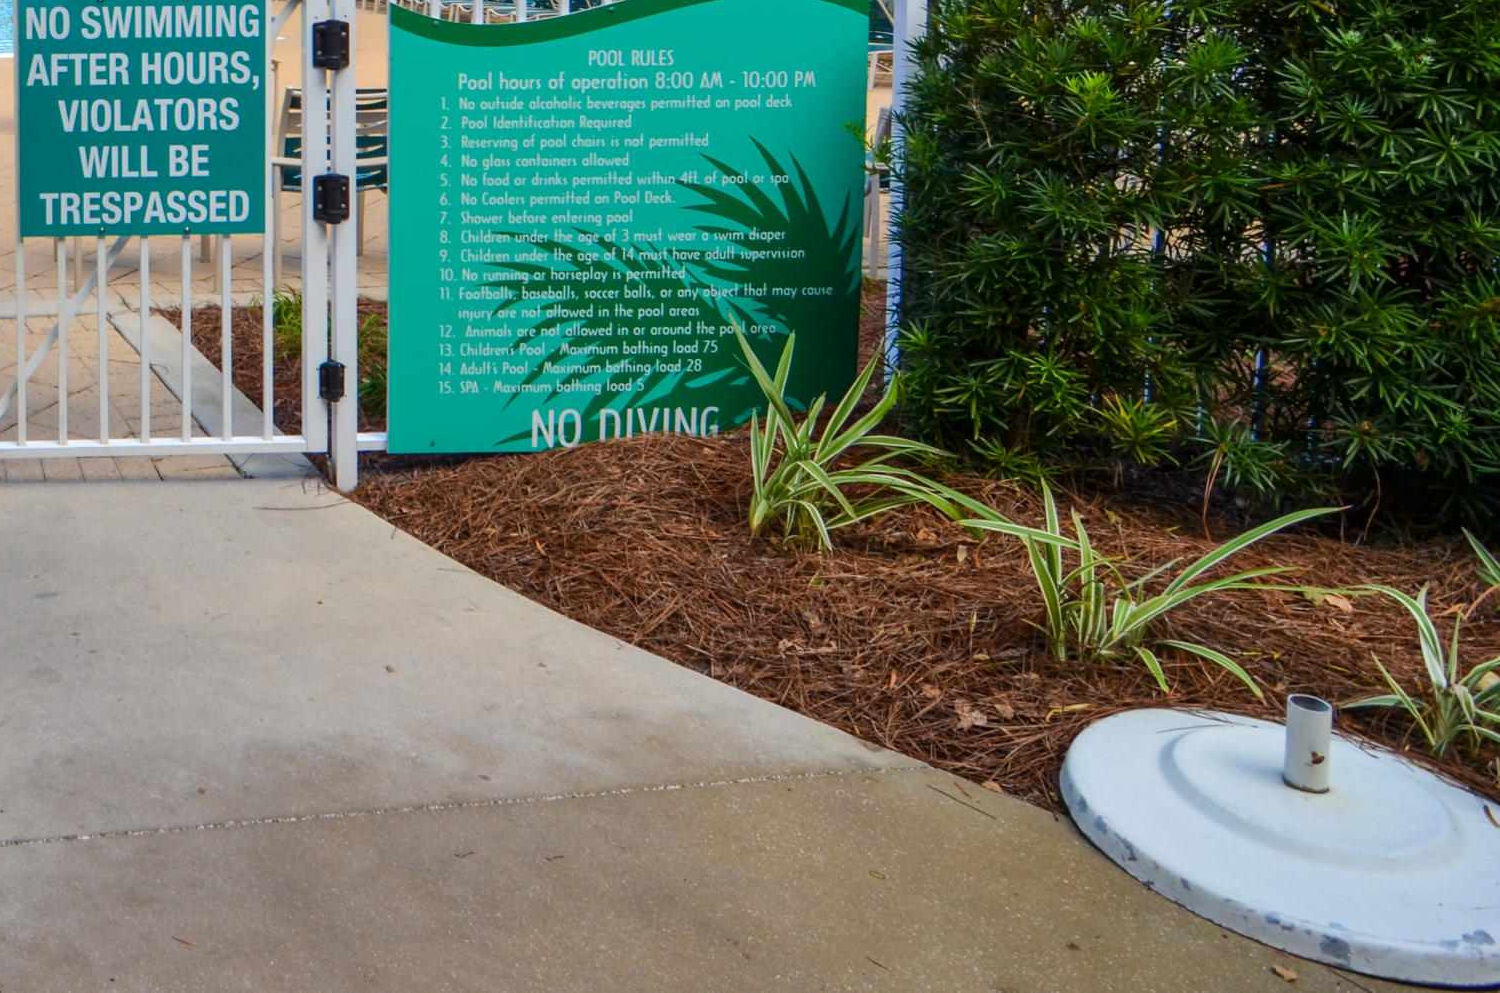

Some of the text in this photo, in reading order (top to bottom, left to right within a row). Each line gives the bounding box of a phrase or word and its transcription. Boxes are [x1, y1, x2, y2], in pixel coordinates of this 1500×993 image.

[26, 5, 259, 39] NO SWIMMING
[588, 50, 674, 66] POOL RULES
[27, 51, 259, 89] AFTER HOURS,
[459, 71, 492, 90] Pool
[499, 72, 541, 90] hours
[548, 71, 564, 89] of
[571, 71, 648, 93] operation
[655, 71, 693, 89] 8:00
[700, 71, 723, 88] AM
[743, 71, 788, 88] 10:00
[795, 71, 815, 87] PM
[441, 94, 791, 112] 1. No outside alcoholic beverages permitted on pool deck
[59, 98, 239, 132] VIOLATORS
[441, 114, 631, 130] 2. Pool Identification Required
[442, 133, 708, 151] 3. Reserving of pool chairs is not permitted
[79, 145, 209, 177] WILL BE
[441, 152, 629, 170] 4. No glass containers allowed
[440, 173, 451, 186] 5.
[461, 173, 477, 186] No
[482, 172, 509, 186] food
[514, 177, 526, 185] or
[532, 172, 567, 185] drinks
[572, 172, 632, 187] permitted
[637, 171, 675, 184] within
[705, 171, 716, 184] of
[722, 171, 747, 186] pool
[753, 175, 764, 183] or
[770, 175, 788, 186] spa
[40, 190, 249, 224] TRESPASSED
[440, 190, 675, 207] 6. No Coolers permitted on Pool Deck.
[441, 209, 633, 226] 7. Shower before entering pool
[440, 230, 451, 243] 8.
[461, 230, 510, 243] Children
[515, 229, 548, 242] under
[554, 230, 572, 242] the
[578, 234, 599, 245] age
[604, 228, 616, 242] of
[623, 229, 629, 242] 3
[634, 228, 662, 241] must
[668, 233, 696, 241] wear
[714, 228, 743, 240] swim
[749, 227, 785, 242] diaper
[440, 246, 804, 264] 9. Children under the age of 14 must have adult supervision
[440, 265, 685, 284] 10. No running or horseplay is permitted
[441, 284, 832, 300] 11. Footballs, baseballs, soccer balls, or any object that may cause
[459, 303, 699, 321] injury are not allowed in the pool areas
[439, 381, 455, 394] 15.
[460, 381, 479, 393] SPA
[493, 380, 551, 393] Maximum
[556, 379, 601, 395] bathing
[607, 378, 632, 391] load
[637, 378, 644, 390] 5
[532, 406, 720, 451] NO DIVING
